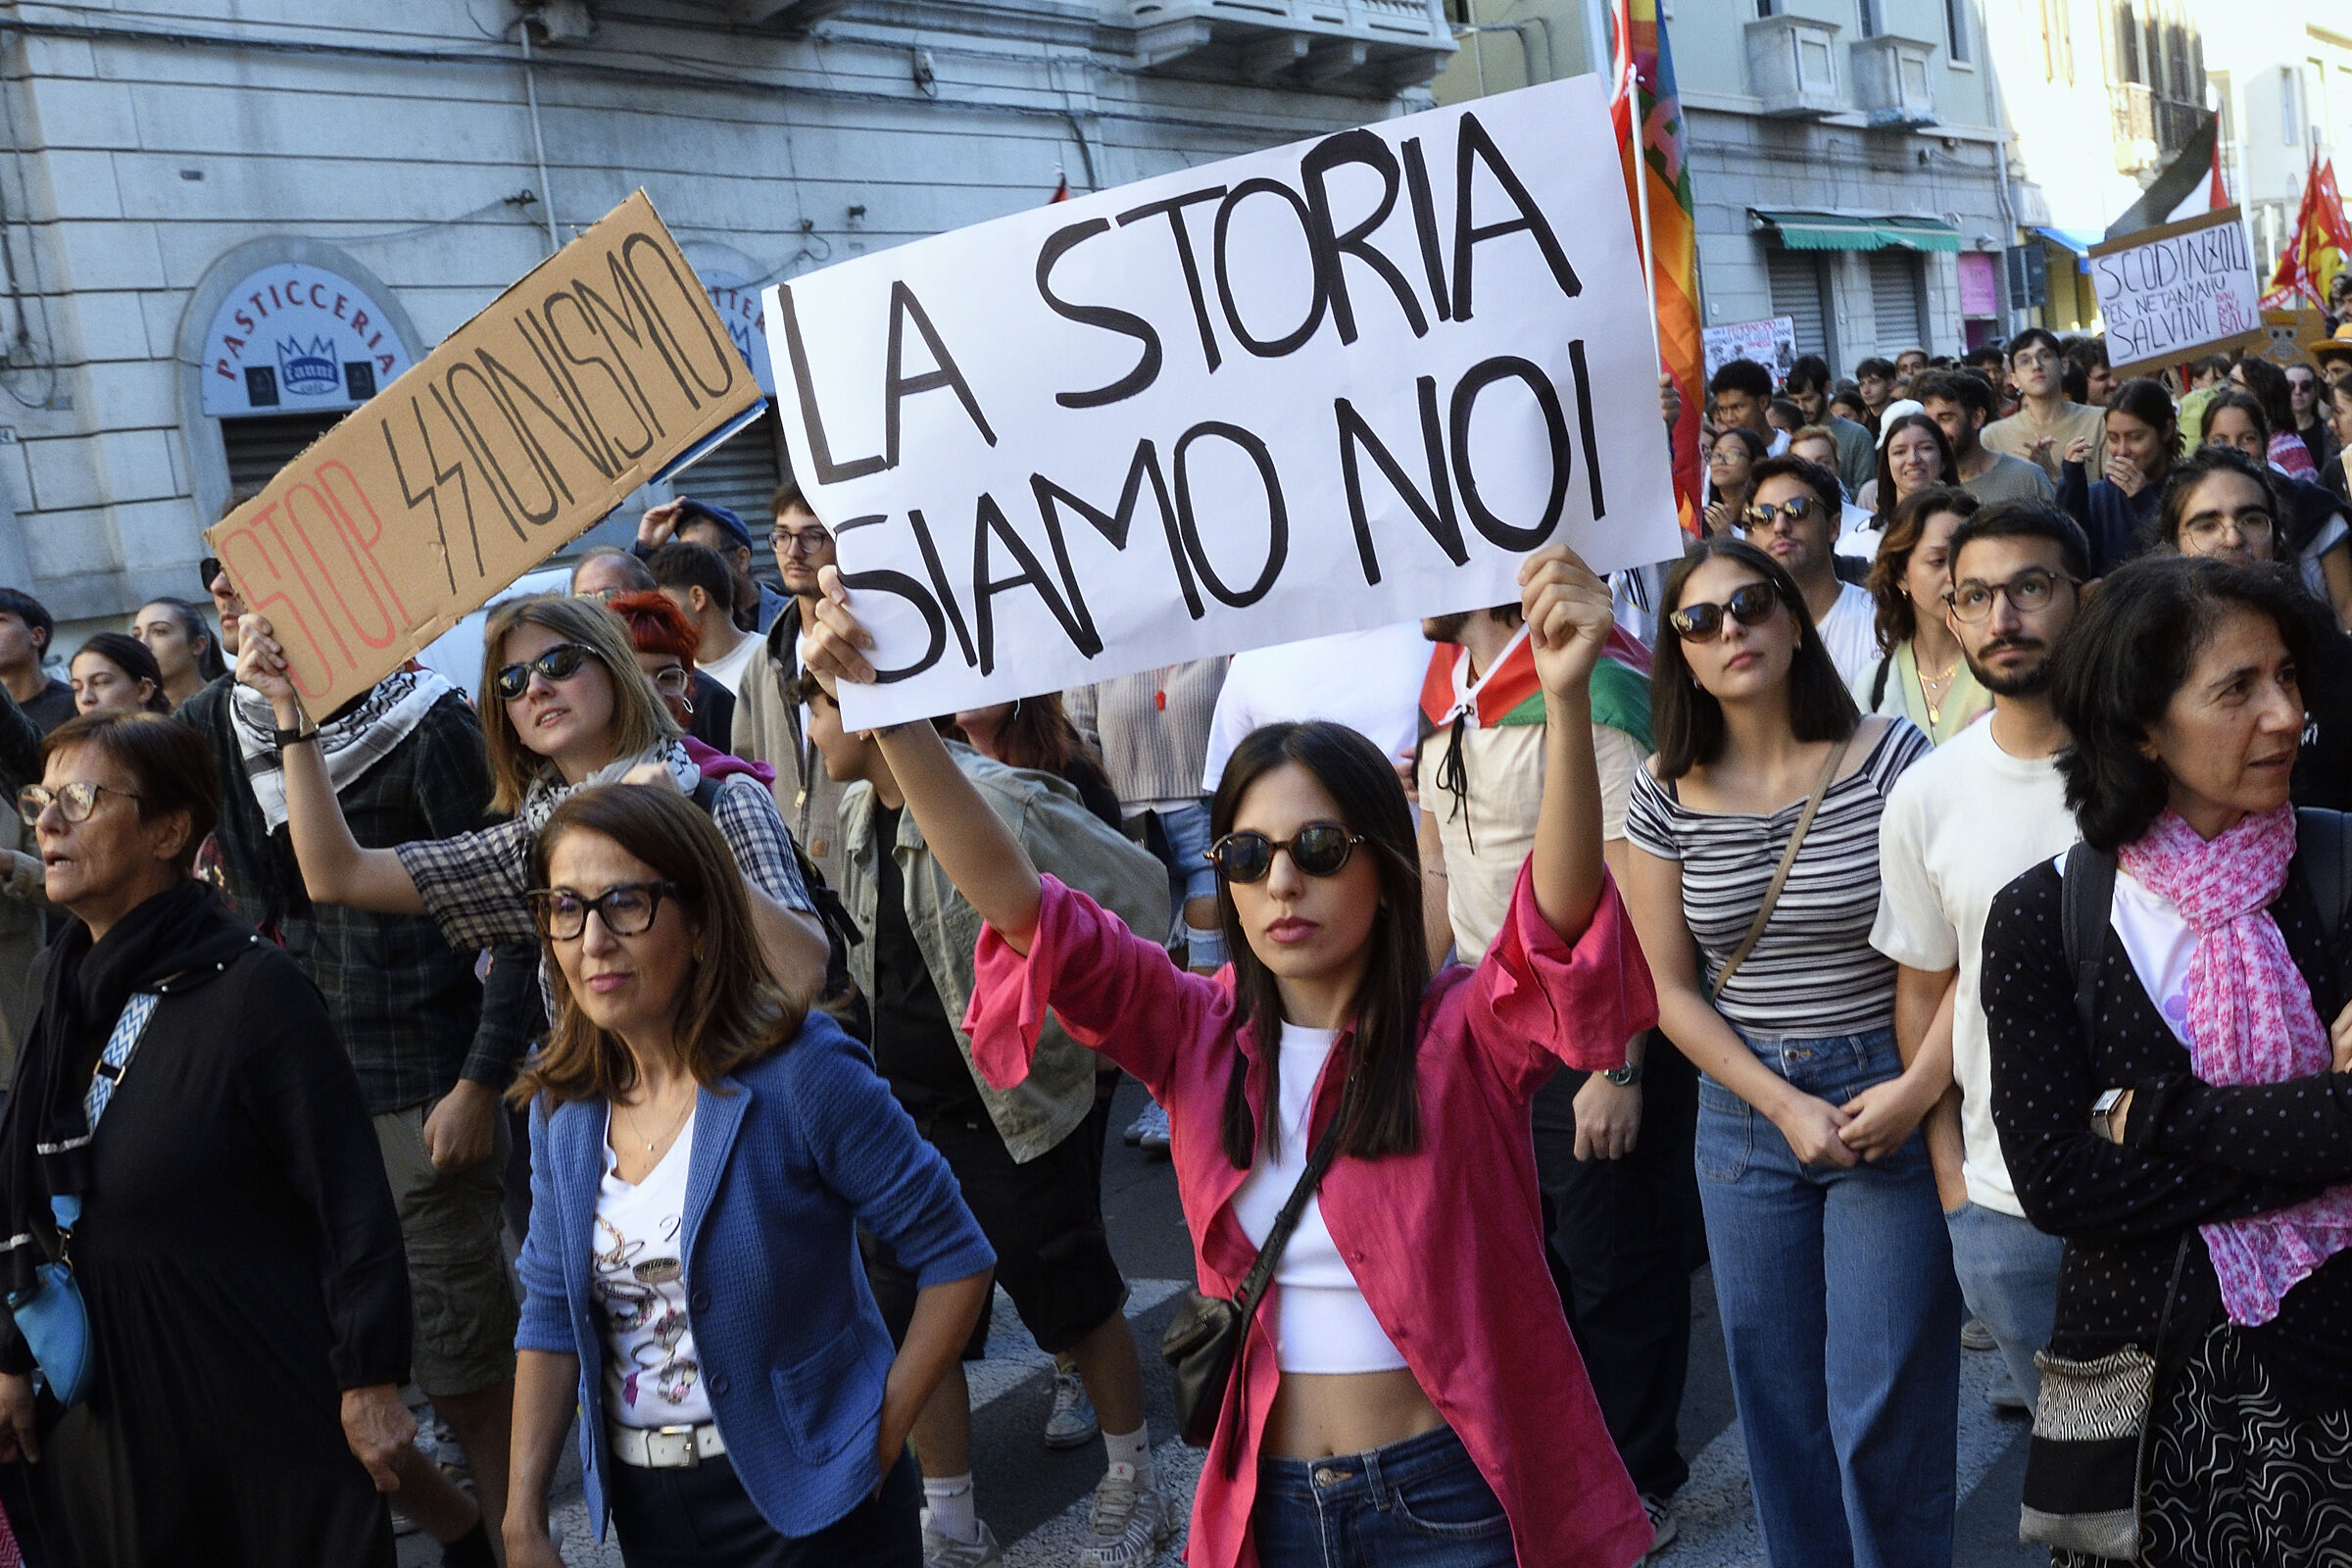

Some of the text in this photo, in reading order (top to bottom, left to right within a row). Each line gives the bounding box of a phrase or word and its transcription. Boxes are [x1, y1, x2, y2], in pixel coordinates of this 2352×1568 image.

[777, 111, 1582, 485] LA STORIA
[2097, 221, 2249, 300] SCODINZOLI
[217, 279, 396, 381] PASTICCERIA
[2100, 301, 2132, 325] PER
[2111, 300, 2211, 361] SALVINI
[833, 339, 1607, 685] SIAMO NOI
[220, 460, 414, 699] STOP
